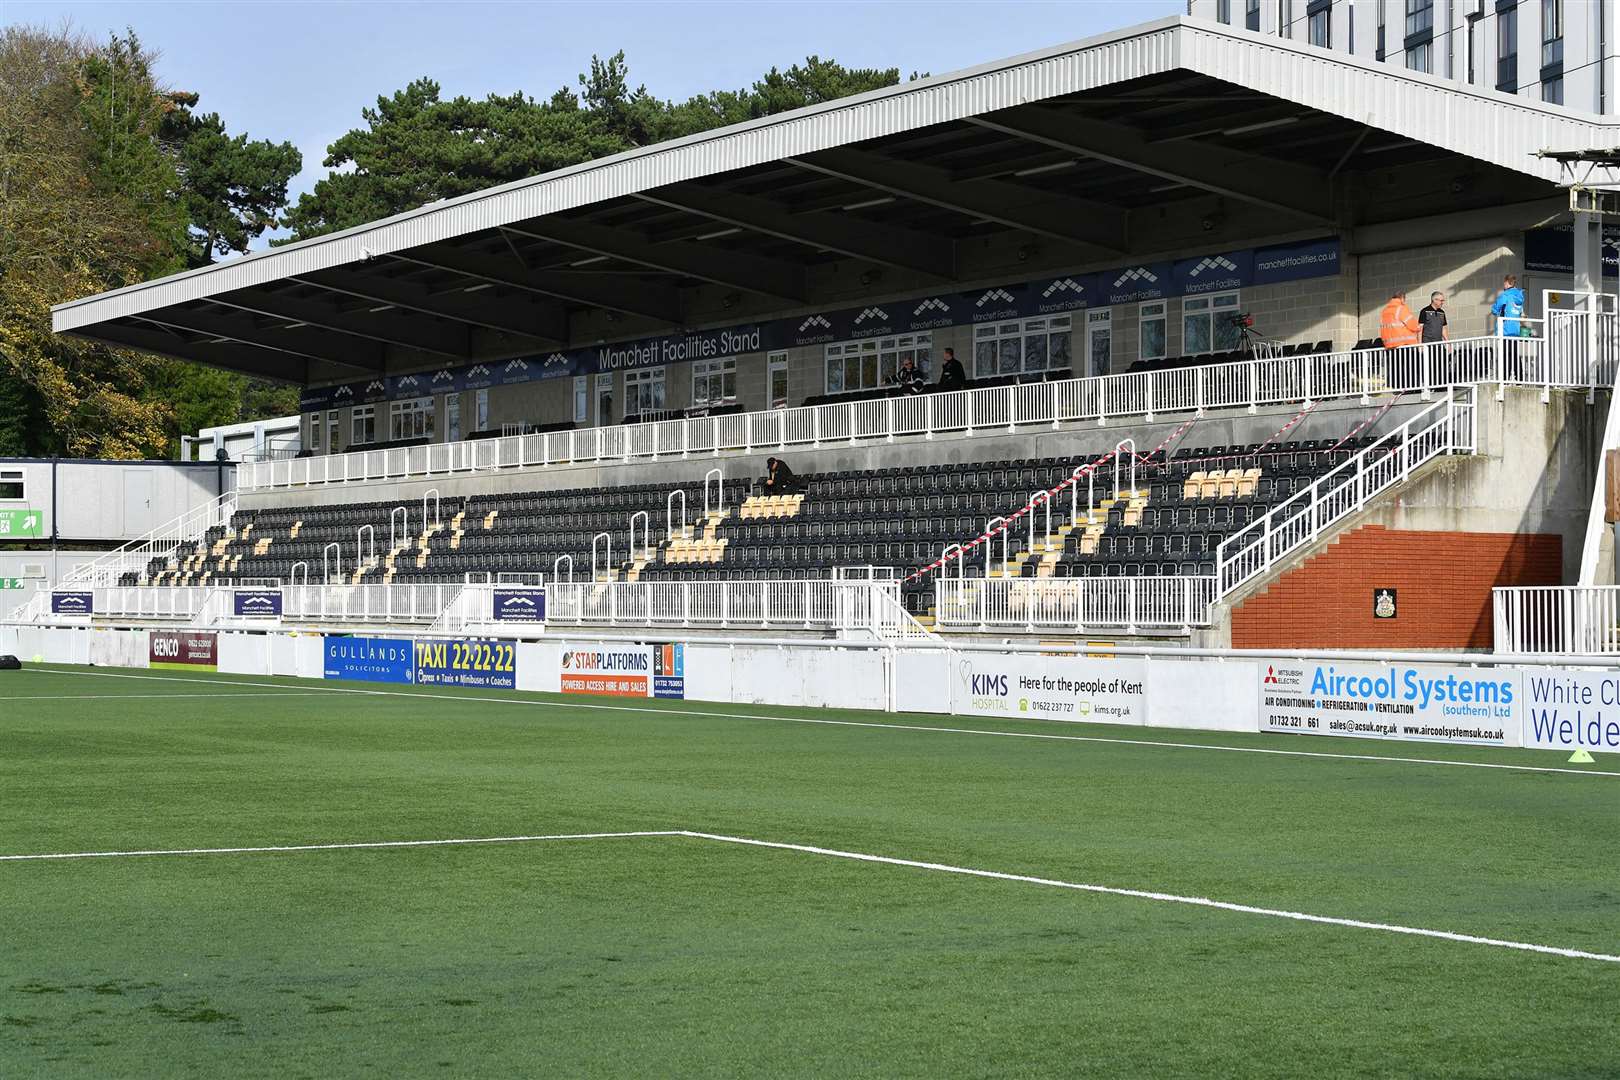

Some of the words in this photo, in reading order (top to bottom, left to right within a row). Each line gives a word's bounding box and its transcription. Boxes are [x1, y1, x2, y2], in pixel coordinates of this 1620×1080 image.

[1258, 252, 1336, 271] manchettfacilities.co.uk
[1185, 281, 1215, 292] Manchett
[1216, 279, 1240, 289] Facilities
[600, 342, 659, 370] Manchett
[662, 336, 717, 362] Facilities
[720, 328, 760, 354] Stand
[154, 638, 178, 656] GENCO
[330, 646, 406, 662] GULLANDS
[416, 644, 447, 668] TAXI
[344, 664, 390, 672] SOLICITORS
[442, 674, 454, 682] Taxis
[460, 674, 484, 685] Minibuses
[490, 676, 512, 686] Coaches
[562, 680, 586, 690] POWERED
[586, 680, 604, 691] ACCESS
[606, 680, 617, 692] HIRE
[618, 681, 630, 692] AND
[631, 682, 646, 692] SALES
[972, 674, 1008, 696] KIMS
[1020, 676, 1040, 690] Here
[1042, 676, 1055, 690] for
[1057, 677, 1073, 692] the
[1074, 678, 1106, 696] people
[1108, 678, 1119, 694] of
[1121, 680, 1143, 695] Kent
[1310, 666, 1396, 699] Aircool
[1404, 669, 1513, 710] Systems
[1531, 677, 1592, 704] White
[972, 699, 1008, 711] HOSPITAL
[1032, 702, 1050, 712] 01622
[1051, 702, 1063, 712] 237
[1064, 703, 1074, 712] 727
[1094, 704, 1130, 718] kims.org.uk
[1265, 697, 1275, 706] AIR
[1276, 698, 1316, 709] CONDITIONING
[1322, 700, 1368, 712] REFRIGERATION
[1375, 704, 1414, 714] VENTILATION
[1442, 704, 1492, 718] (southern)
[1494, 706, 1510, 718] Ltd
[1270, 715, 1288, 726] 01732
[1290, 716, 1302, 727] 321
[1308, 718, 1320, 728] 661
[1329, 719, 1398, 735] sales@acsuk.org.uk
[1532, 708, 1620, 747] Welde
[1403, 725, 1504, 740] www.aircoolsystemsuk.co.uk
